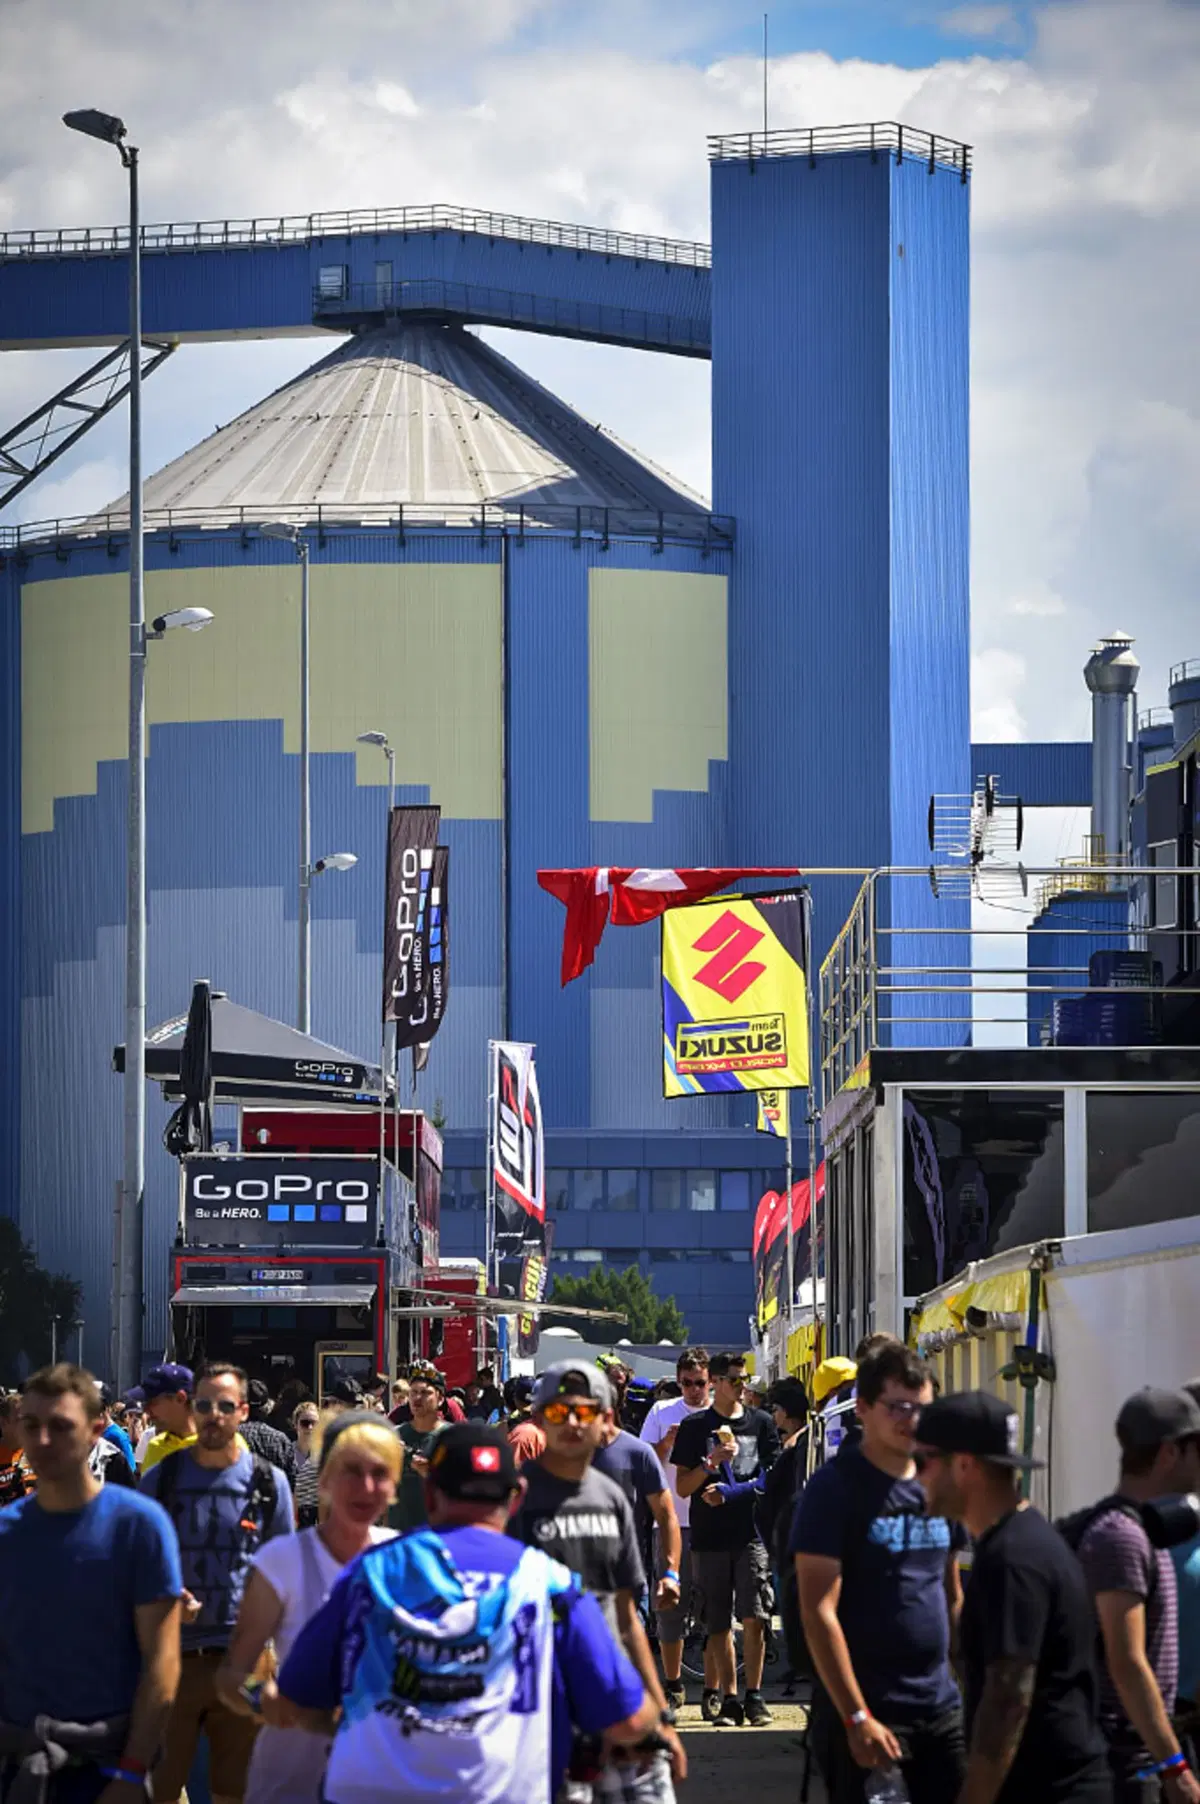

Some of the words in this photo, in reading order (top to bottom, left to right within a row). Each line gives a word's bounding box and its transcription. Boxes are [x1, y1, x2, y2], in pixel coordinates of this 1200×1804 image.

[392, 848, 419, 999] GoPro
[295, 1060, 354, 1076] GoPro
[193, 1174, 370, 1201] GoPro
[195, 1207, 211, 1219] Be
[212, 1209, 220, 1219] a
[221, 1207, 263, 1219] HERO.
